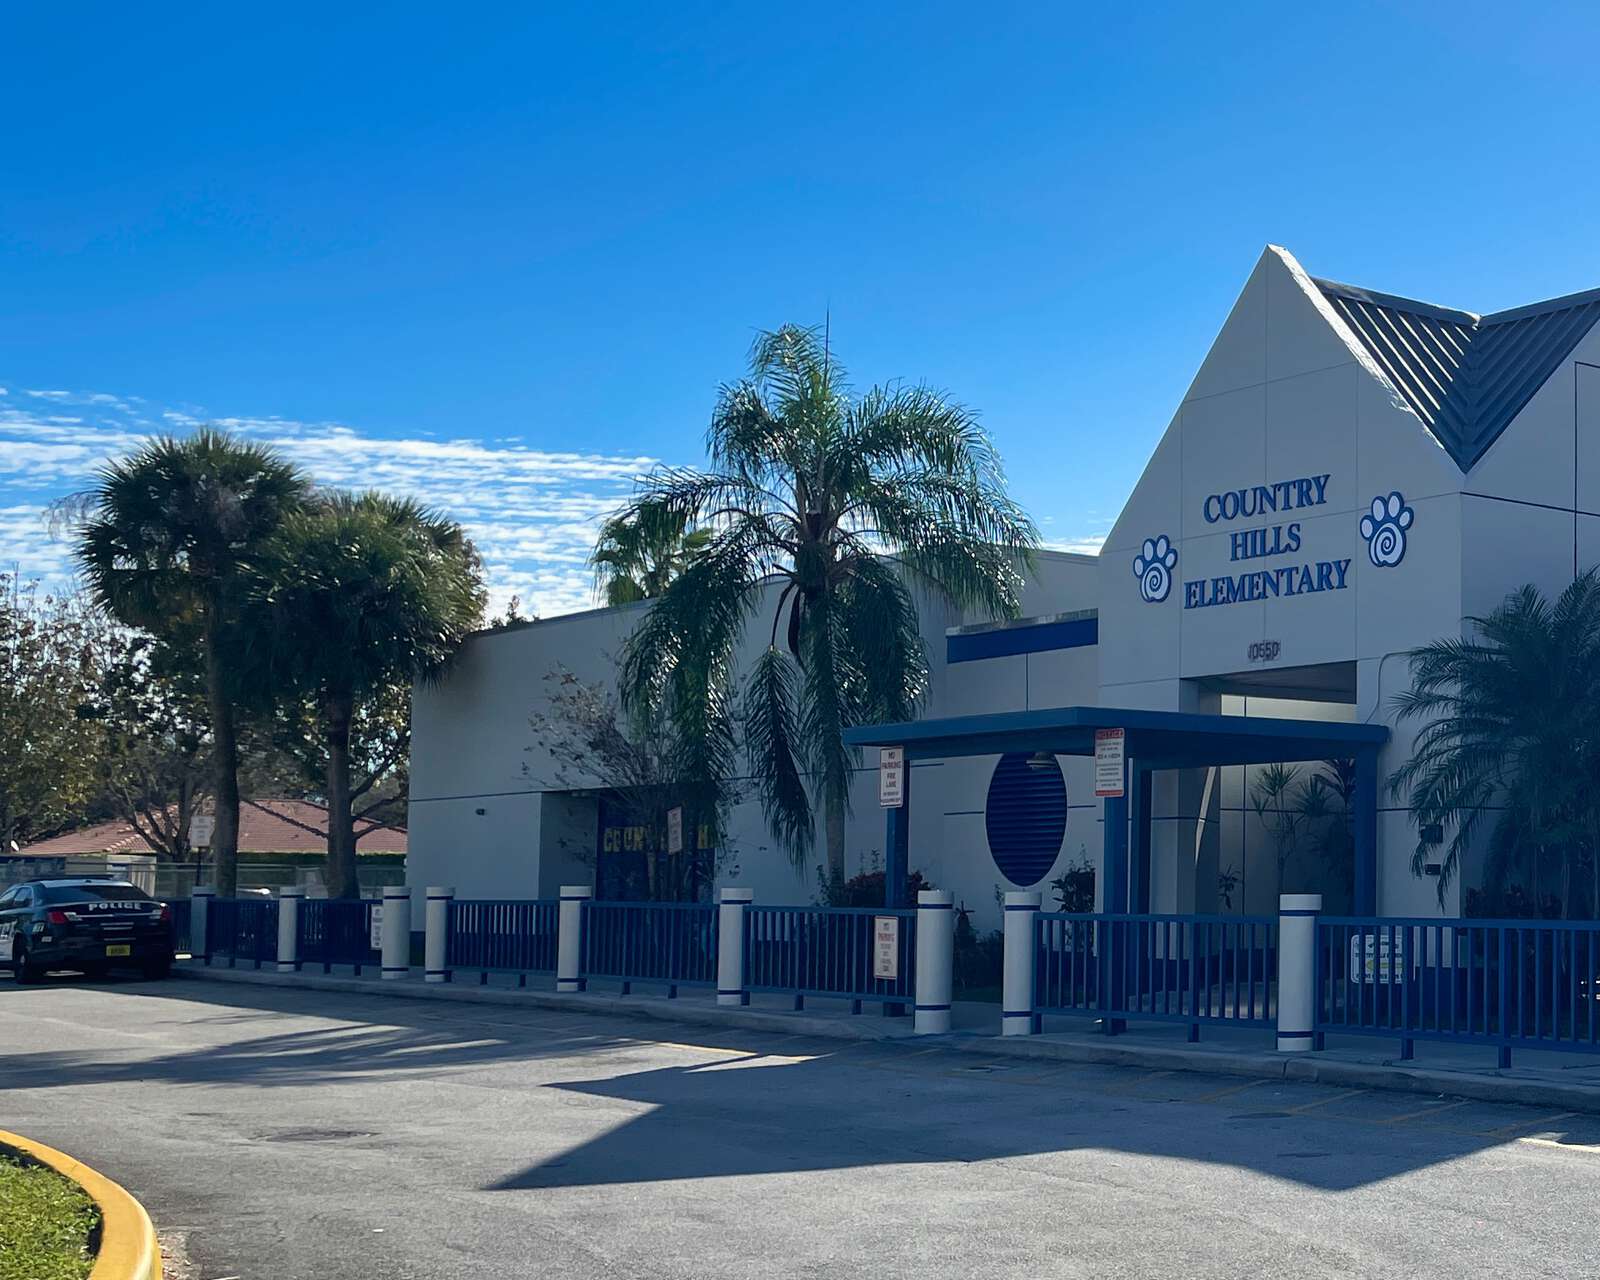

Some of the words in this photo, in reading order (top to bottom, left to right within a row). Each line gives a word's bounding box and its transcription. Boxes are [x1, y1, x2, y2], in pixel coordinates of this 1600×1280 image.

[1203, 474, 1331, 523] COUNTRY
[1229, 523, 1301, 561] HILLS
[1183, 559, 1351, 609] ELEMENTARY
[88, 902, 142, 912] POLICE
